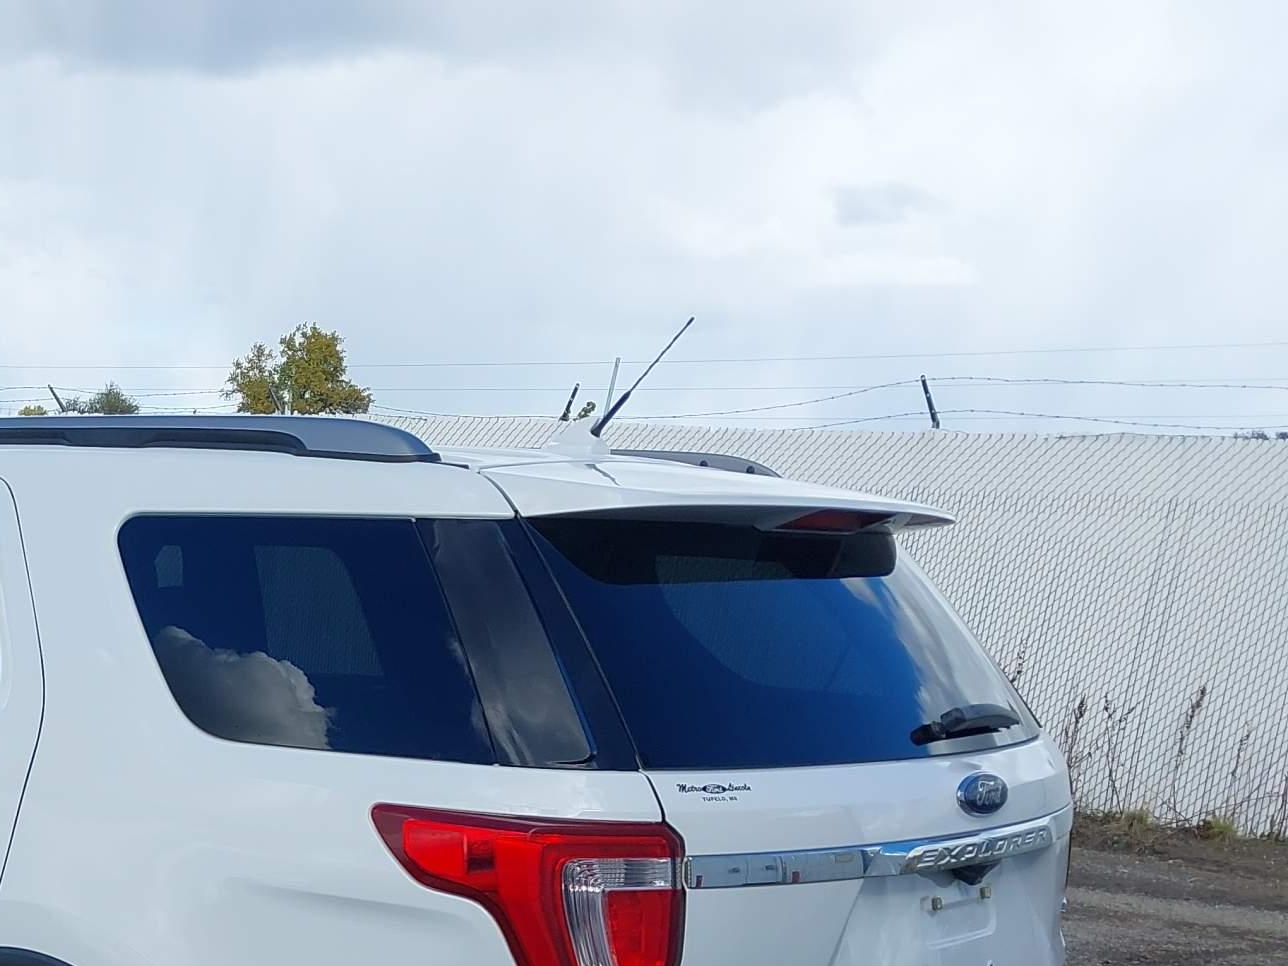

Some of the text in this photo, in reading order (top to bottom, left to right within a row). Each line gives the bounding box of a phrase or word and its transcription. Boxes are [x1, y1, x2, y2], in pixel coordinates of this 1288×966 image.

[676, 783, 702, 793] Metro
[726, 782, 752, 791] Lincoln
[976, 780, 1002, 806] Ford
[916, 827, 1050, 868] EXPLORER
